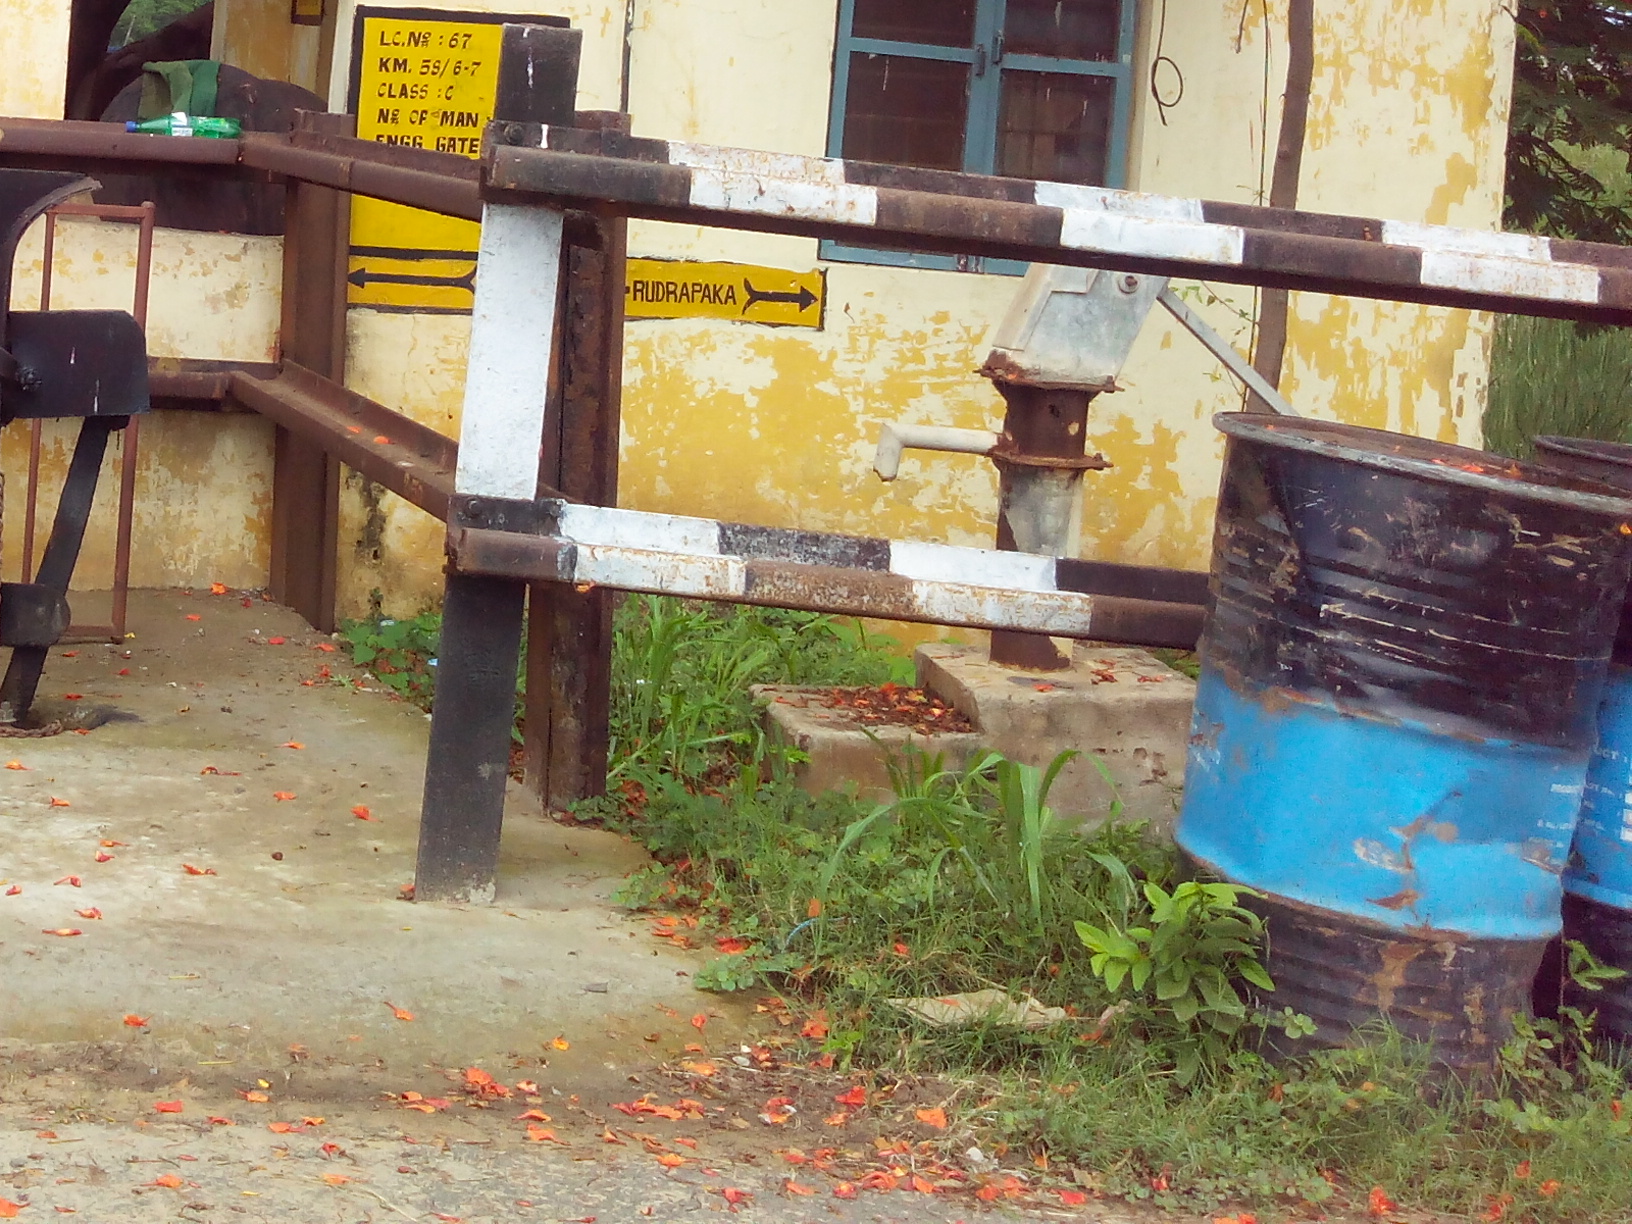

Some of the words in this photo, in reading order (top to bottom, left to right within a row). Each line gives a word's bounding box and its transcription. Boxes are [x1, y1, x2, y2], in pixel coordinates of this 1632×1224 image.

[378, 57, 412, 74] KM.
[377, 82, 429, 99] CLASS
[409, 109, 429, 126] OF
[440, 110, 479, 128] MAN
[436, 136, 480, 154] GATE
